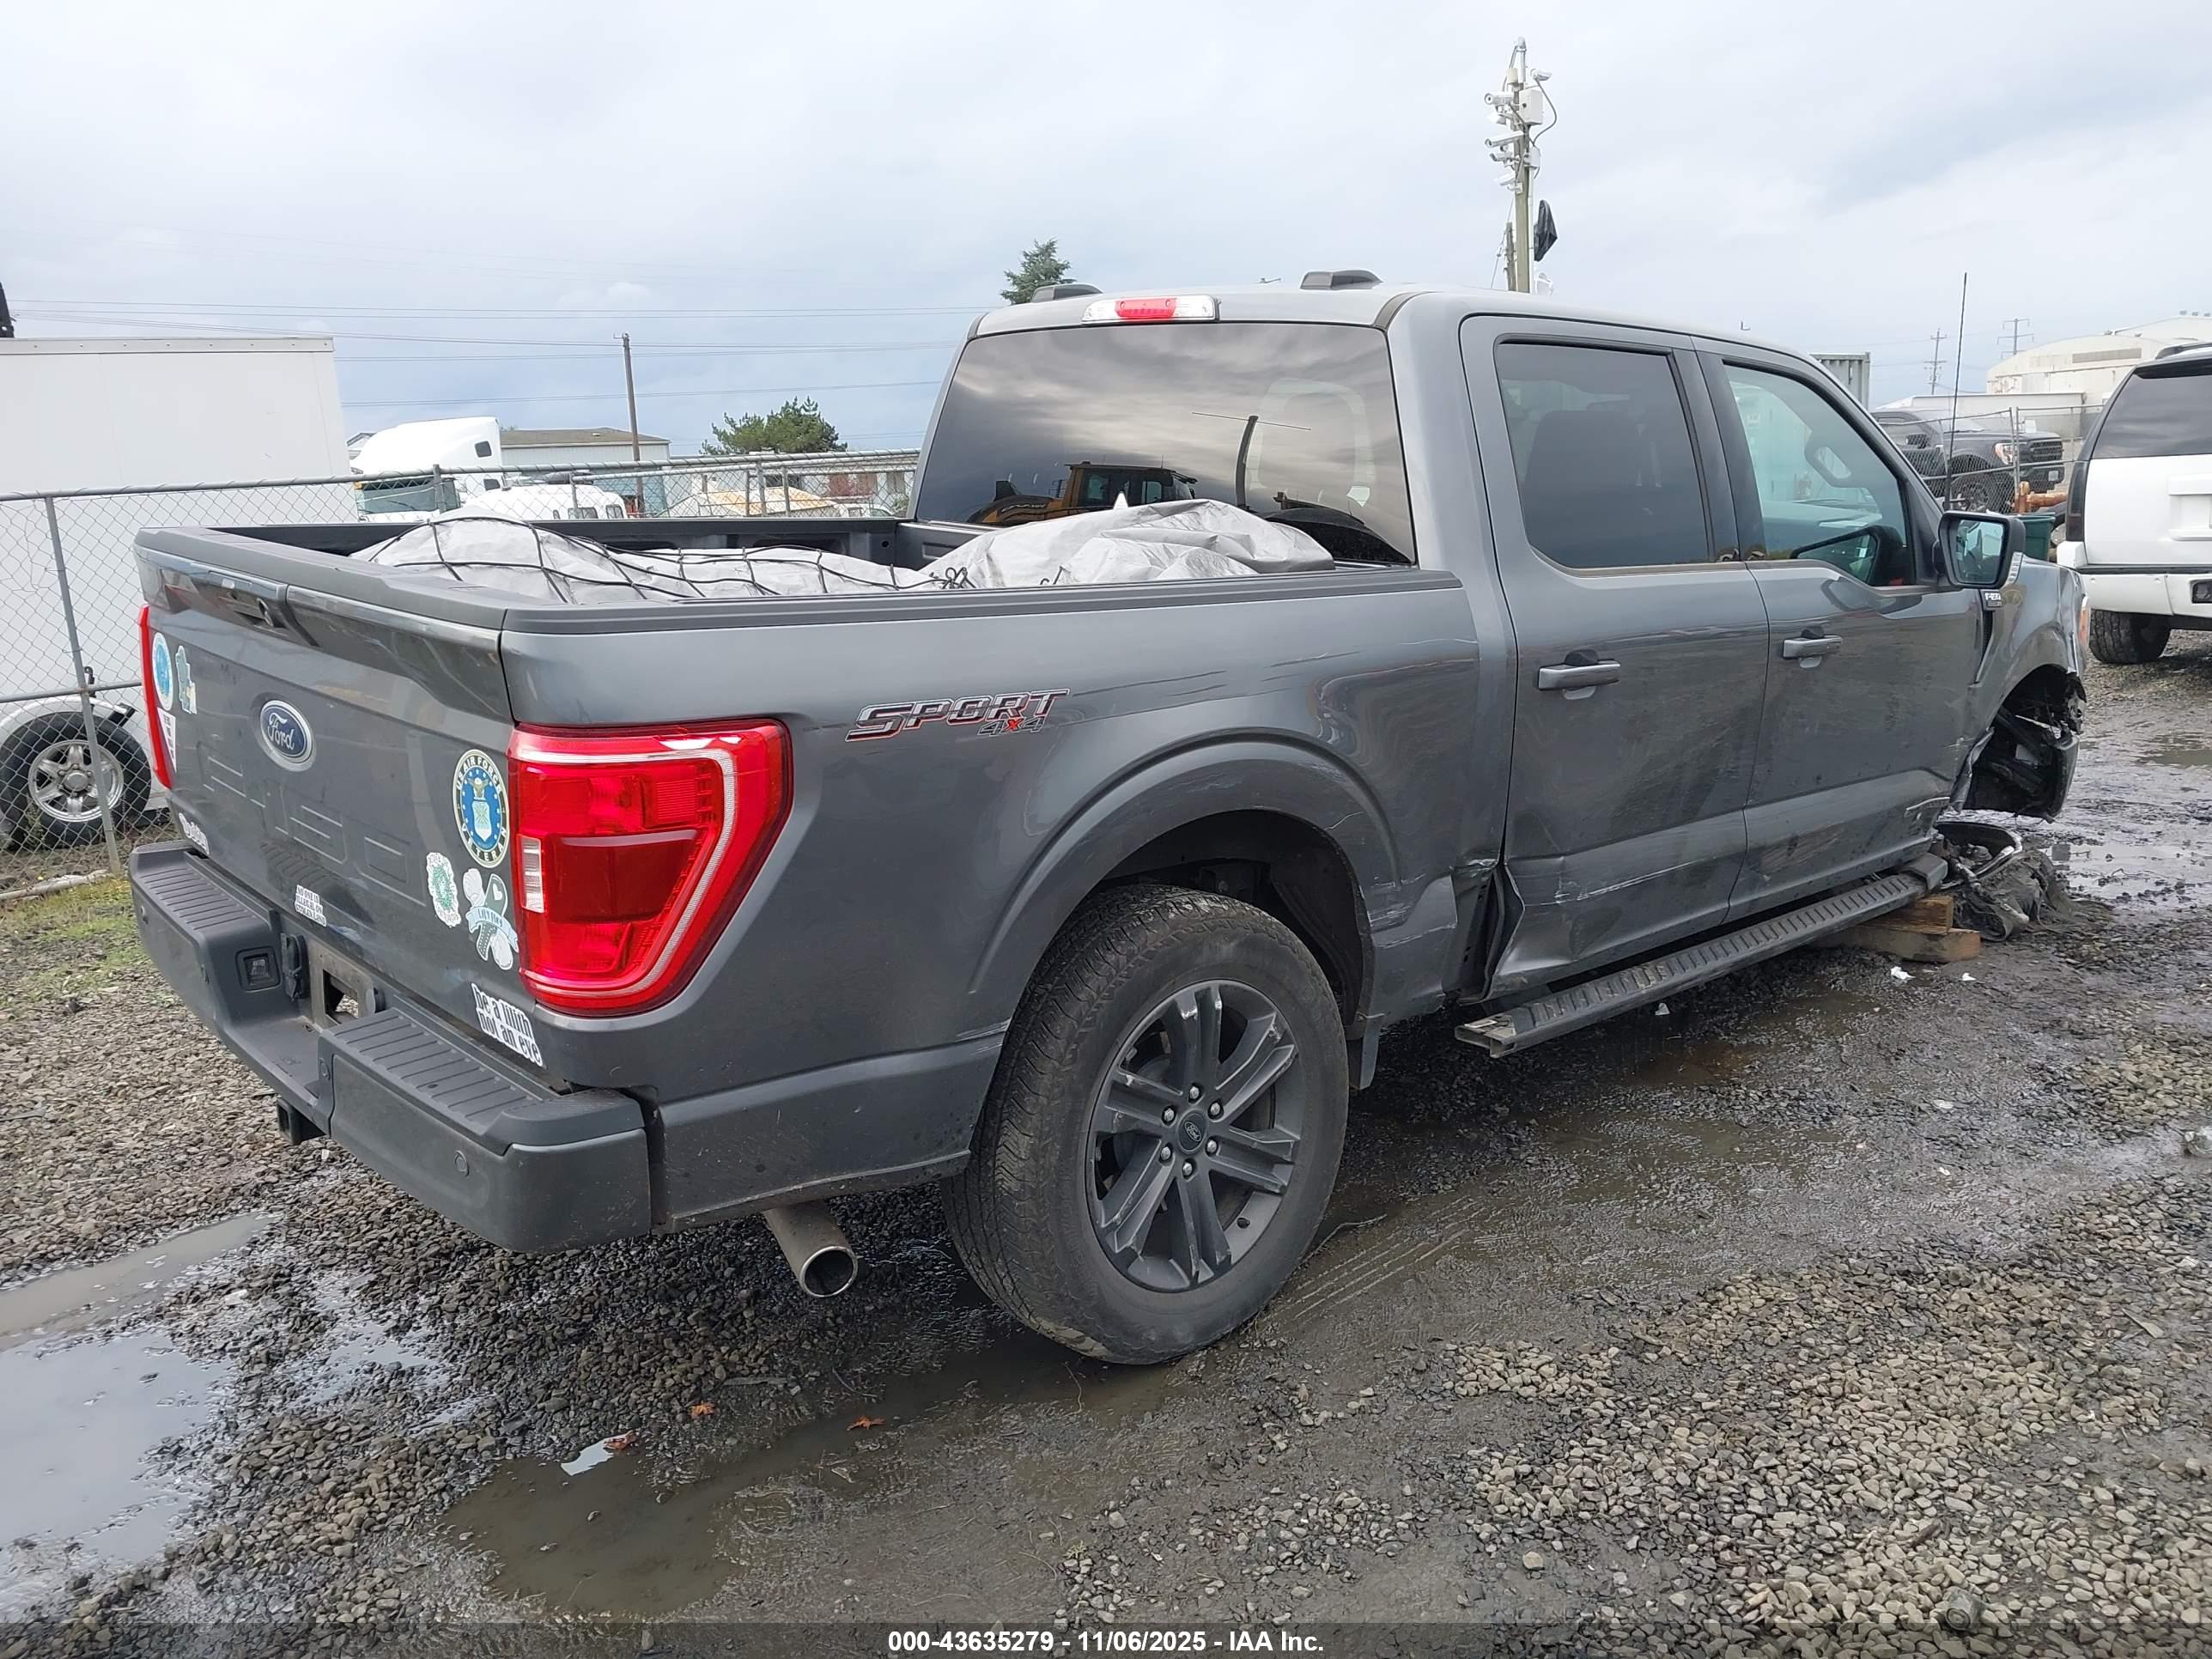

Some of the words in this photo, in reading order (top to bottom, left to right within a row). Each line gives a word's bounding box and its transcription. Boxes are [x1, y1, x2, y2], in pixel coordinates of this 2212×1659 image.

[267, 712, 295, 750] Ford
[845, 689, 1070, 743] SPORT
[456, 772, 464, 791] US
[462, 756, 477, 771] AIR
[477, 756, 503, 795] FORCE
[461, 822, 507, 861] VETERAN
[473, 986, 490, 1014] be
[492, 1000, 501, 1021] a
[501, 1002, 532, 1039] lilith
[480, 1013, 499, 1038] not
[500, 1024, 518, 1049] an
[519, 1035, 541, 1062] eve
